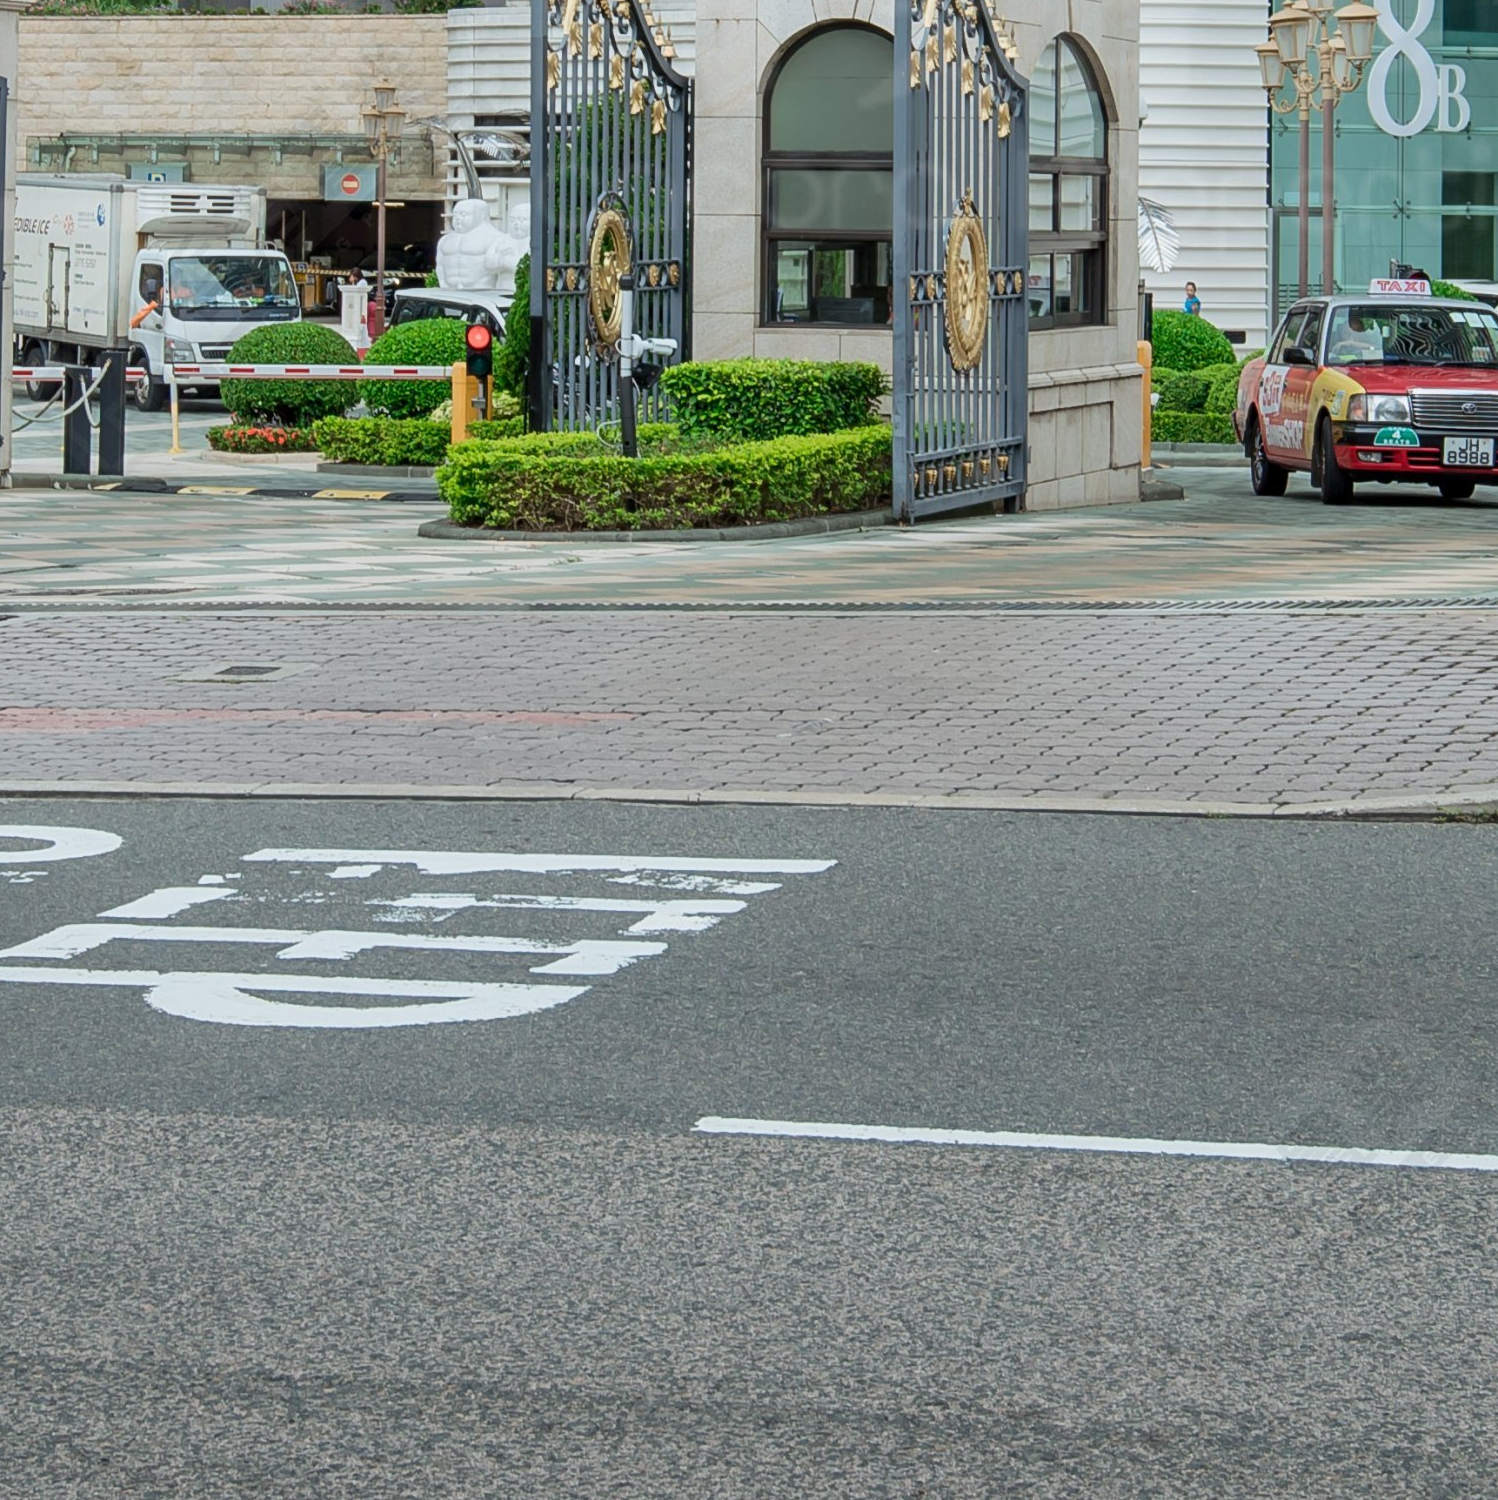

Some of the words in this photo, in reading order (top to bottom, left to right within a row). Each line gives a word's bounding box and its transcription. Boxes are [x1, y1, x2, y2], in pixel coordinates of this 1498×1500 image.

[1377, 280, 1426, 292] TAXI
[1392, 430, 1402, 439] 4
[1458, 438, 1480, 452] JH
[1447, 451, 1490, 465] 8988
